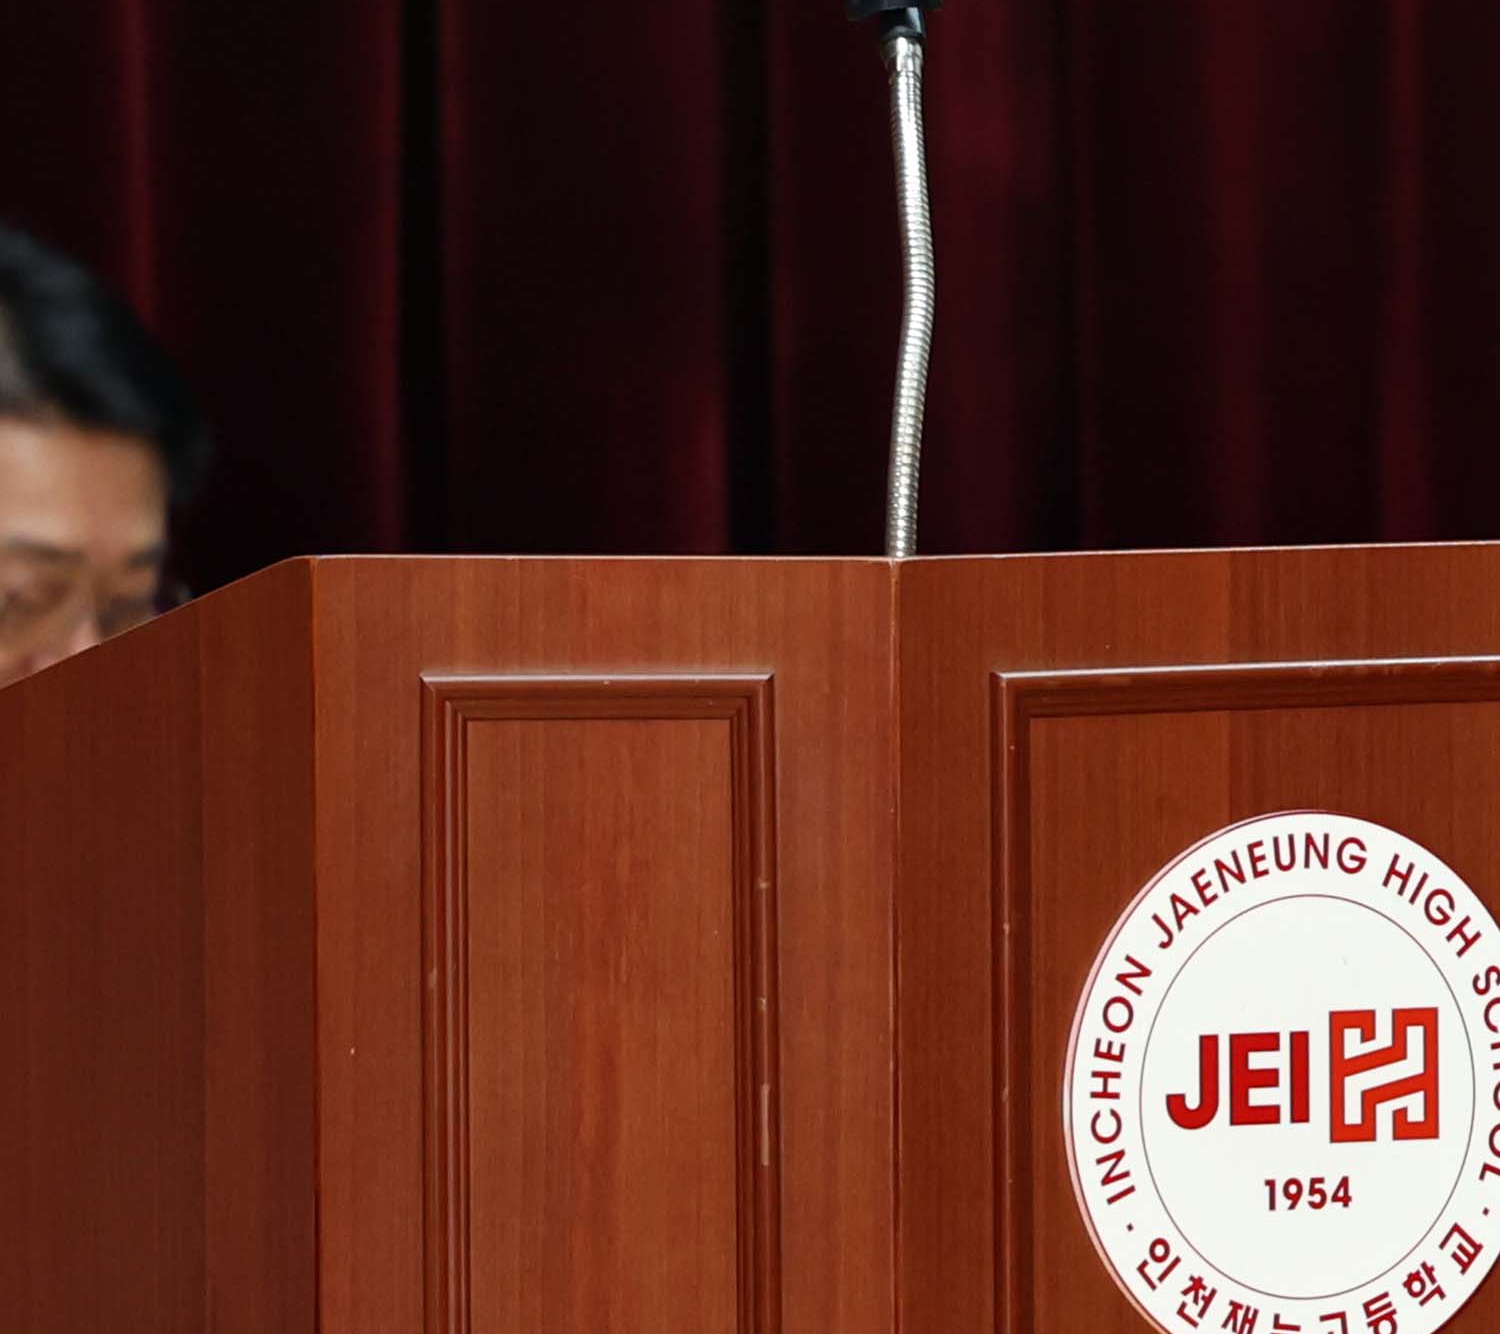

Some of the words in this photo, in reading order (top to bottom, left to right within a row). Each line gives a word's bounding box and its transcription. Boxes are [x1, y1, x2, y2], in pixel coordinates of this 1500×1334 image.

[1090, 954, 1153, 1205] INCHEON
[1151, 832, 1367, 950] JAENEUNG
[1382, 853, 1482, 958] HIGH
[1165, 1029, 1310, 1131] JEI
[1264, 1175, 1353, 1211] 1954
